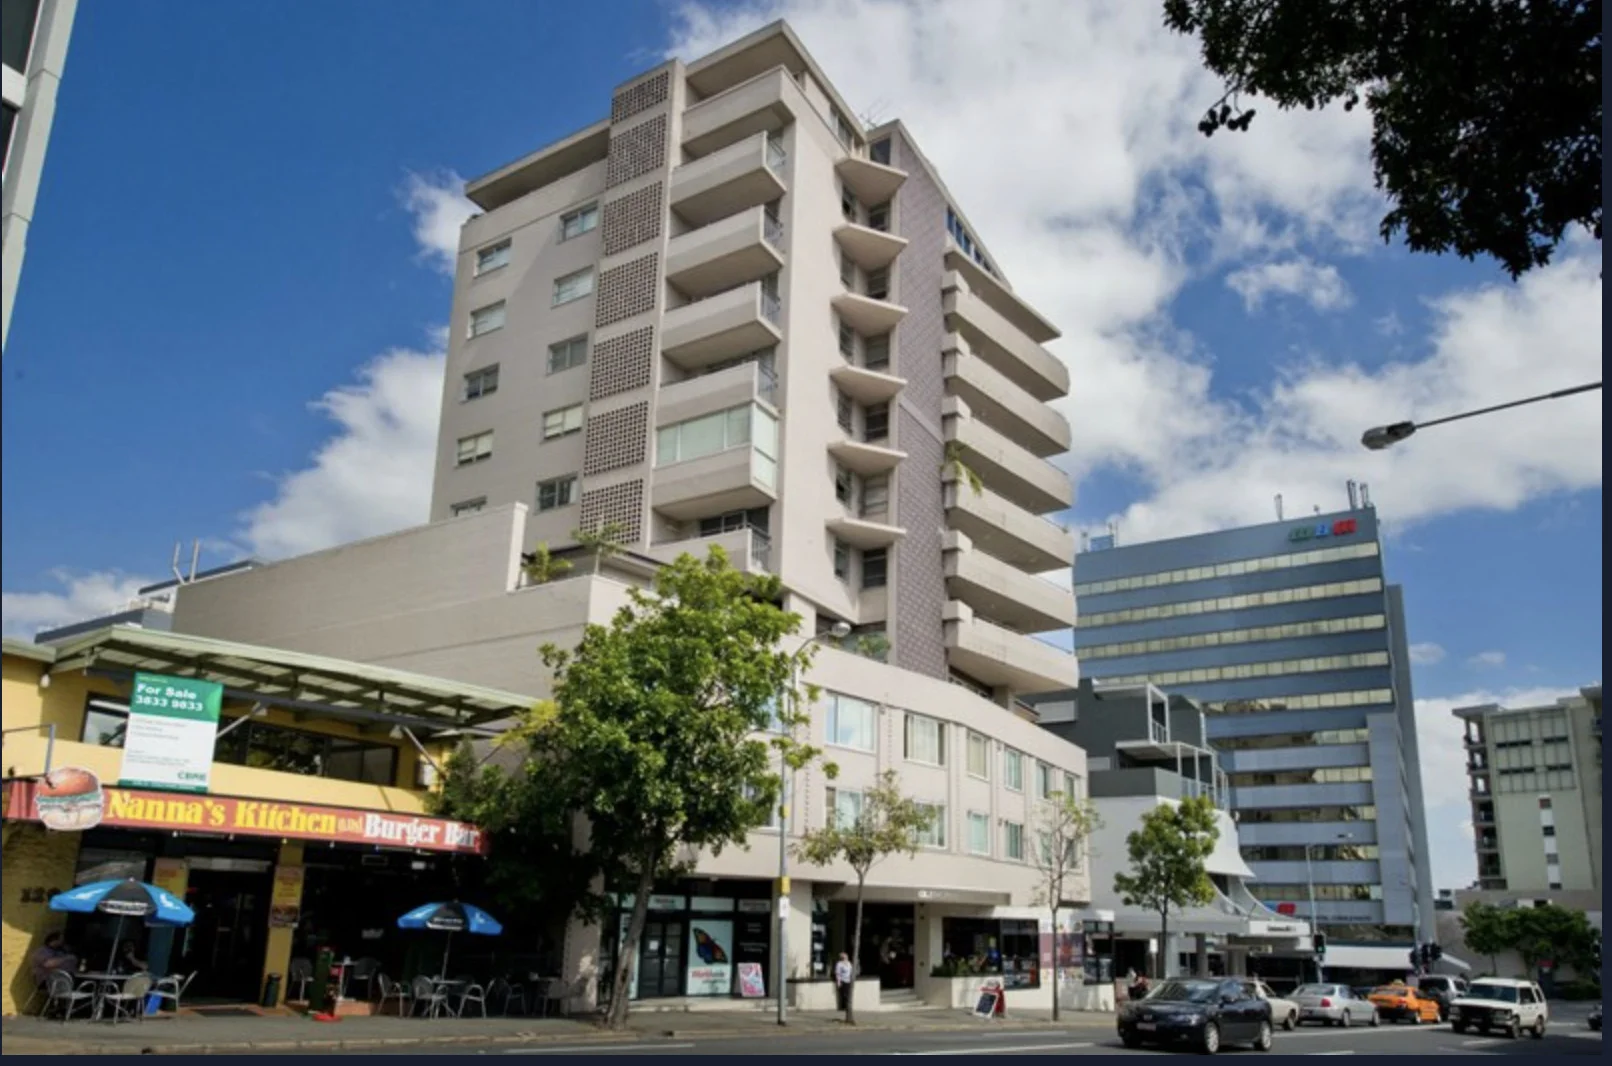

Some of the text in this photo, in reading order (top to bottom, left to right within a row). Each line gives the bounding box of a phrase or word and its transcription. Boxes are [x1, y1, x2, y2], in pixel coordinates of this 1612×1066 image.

[137, 683, 197, 700] For Sale
[106, 789, 226, 826] Nanna's
[234, 800, 337, 835] Kitchen
[364, 813, 440, 846] Burger
[444, 821, 480, 848] Bar
